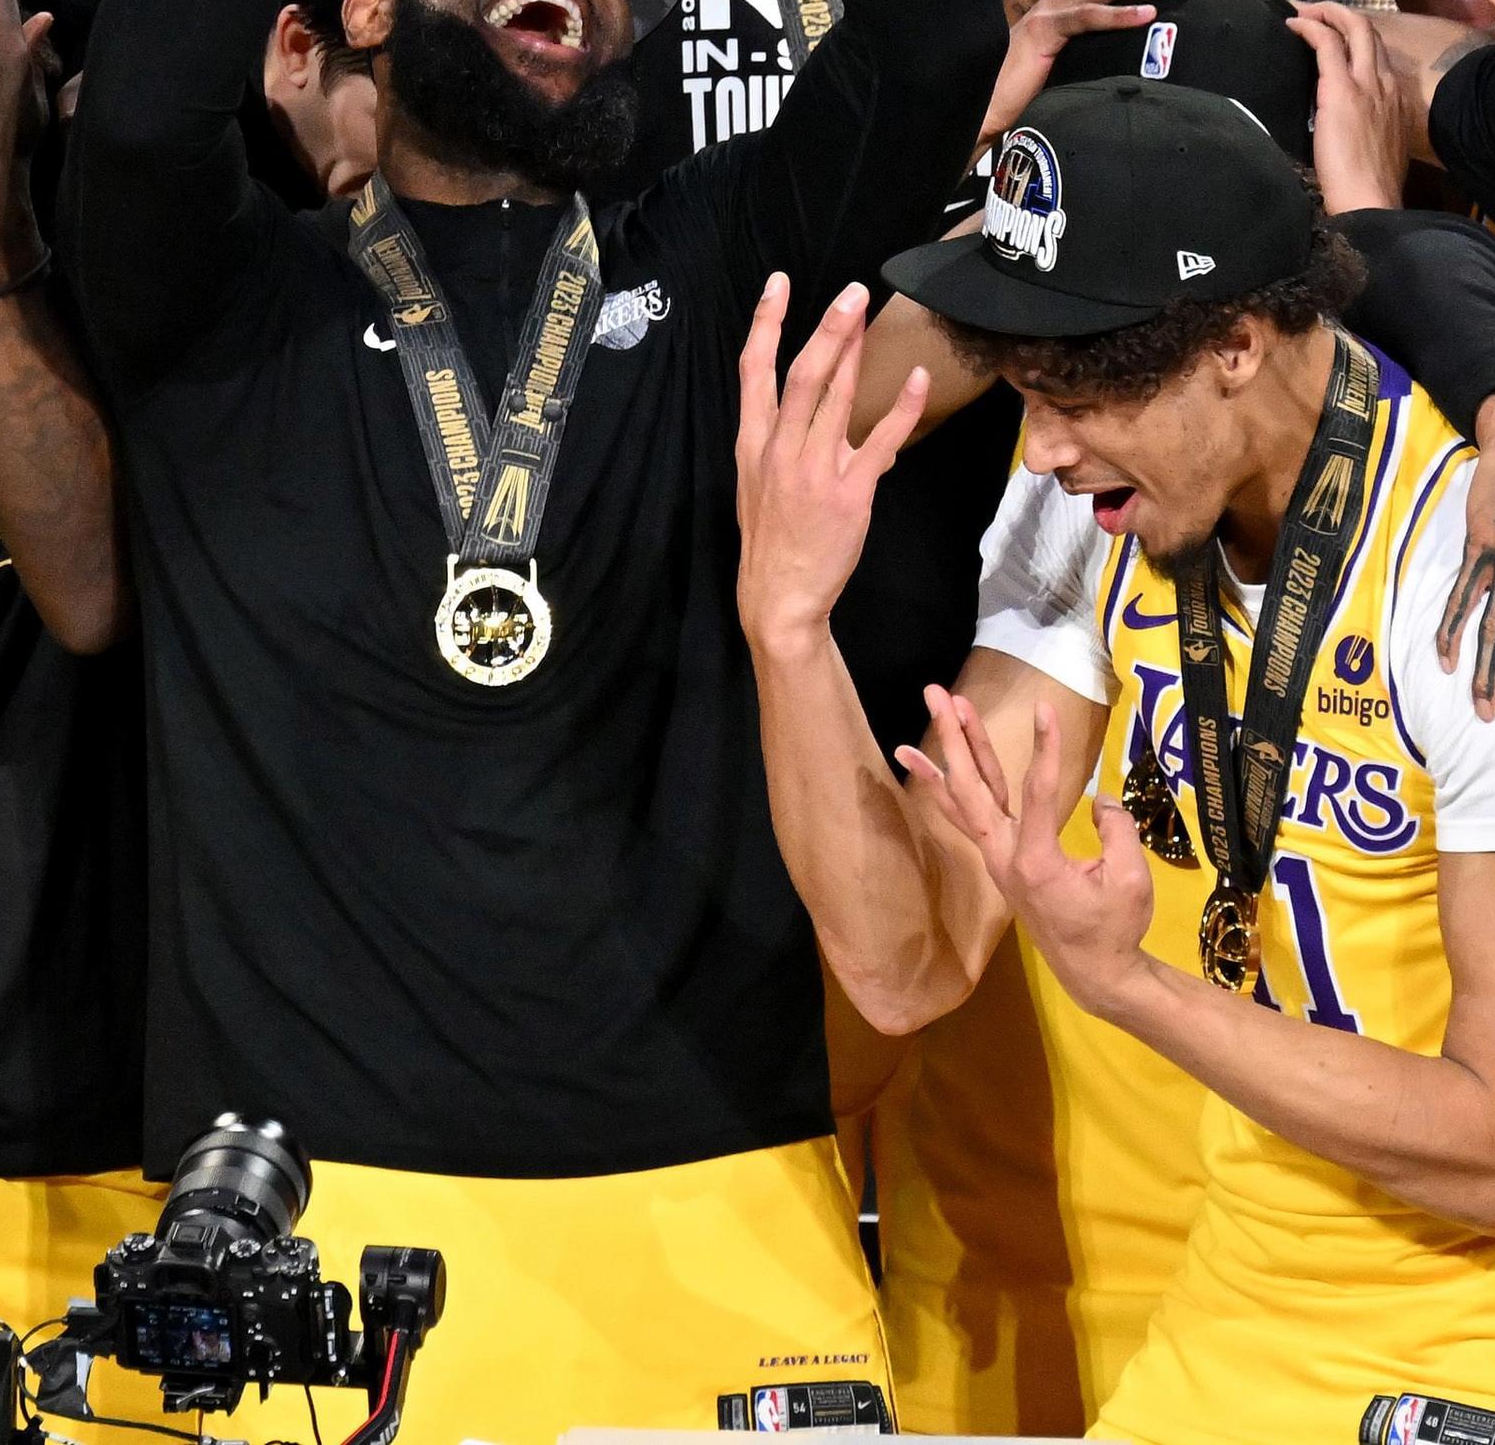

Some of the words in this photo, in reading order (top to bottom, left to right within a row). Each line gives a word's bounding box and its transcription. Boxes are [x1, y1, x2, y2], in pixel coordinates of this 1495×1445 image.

[550, 270, 588, 314] 2023
[425, 367, 479, 467] CHAMPIONS
[1286, 545, 1322, 600] 2023
[1263, 594, 1314, 698] CHAMPIONS
[1317, 686, 1391, 727] bibigo
[1198, 716, 1226, 824] CHAMPIONS
[1213, 825, 1231, 874] 2023
[758, 1356, 809, 1368] LEAVE
[811, 1354, 820, 1365] A
[823, 1353, 871, 1366] LEGACY
[792, 1402, 806, 1414] 54
[1424, 1415, 1440, 1429] 48
